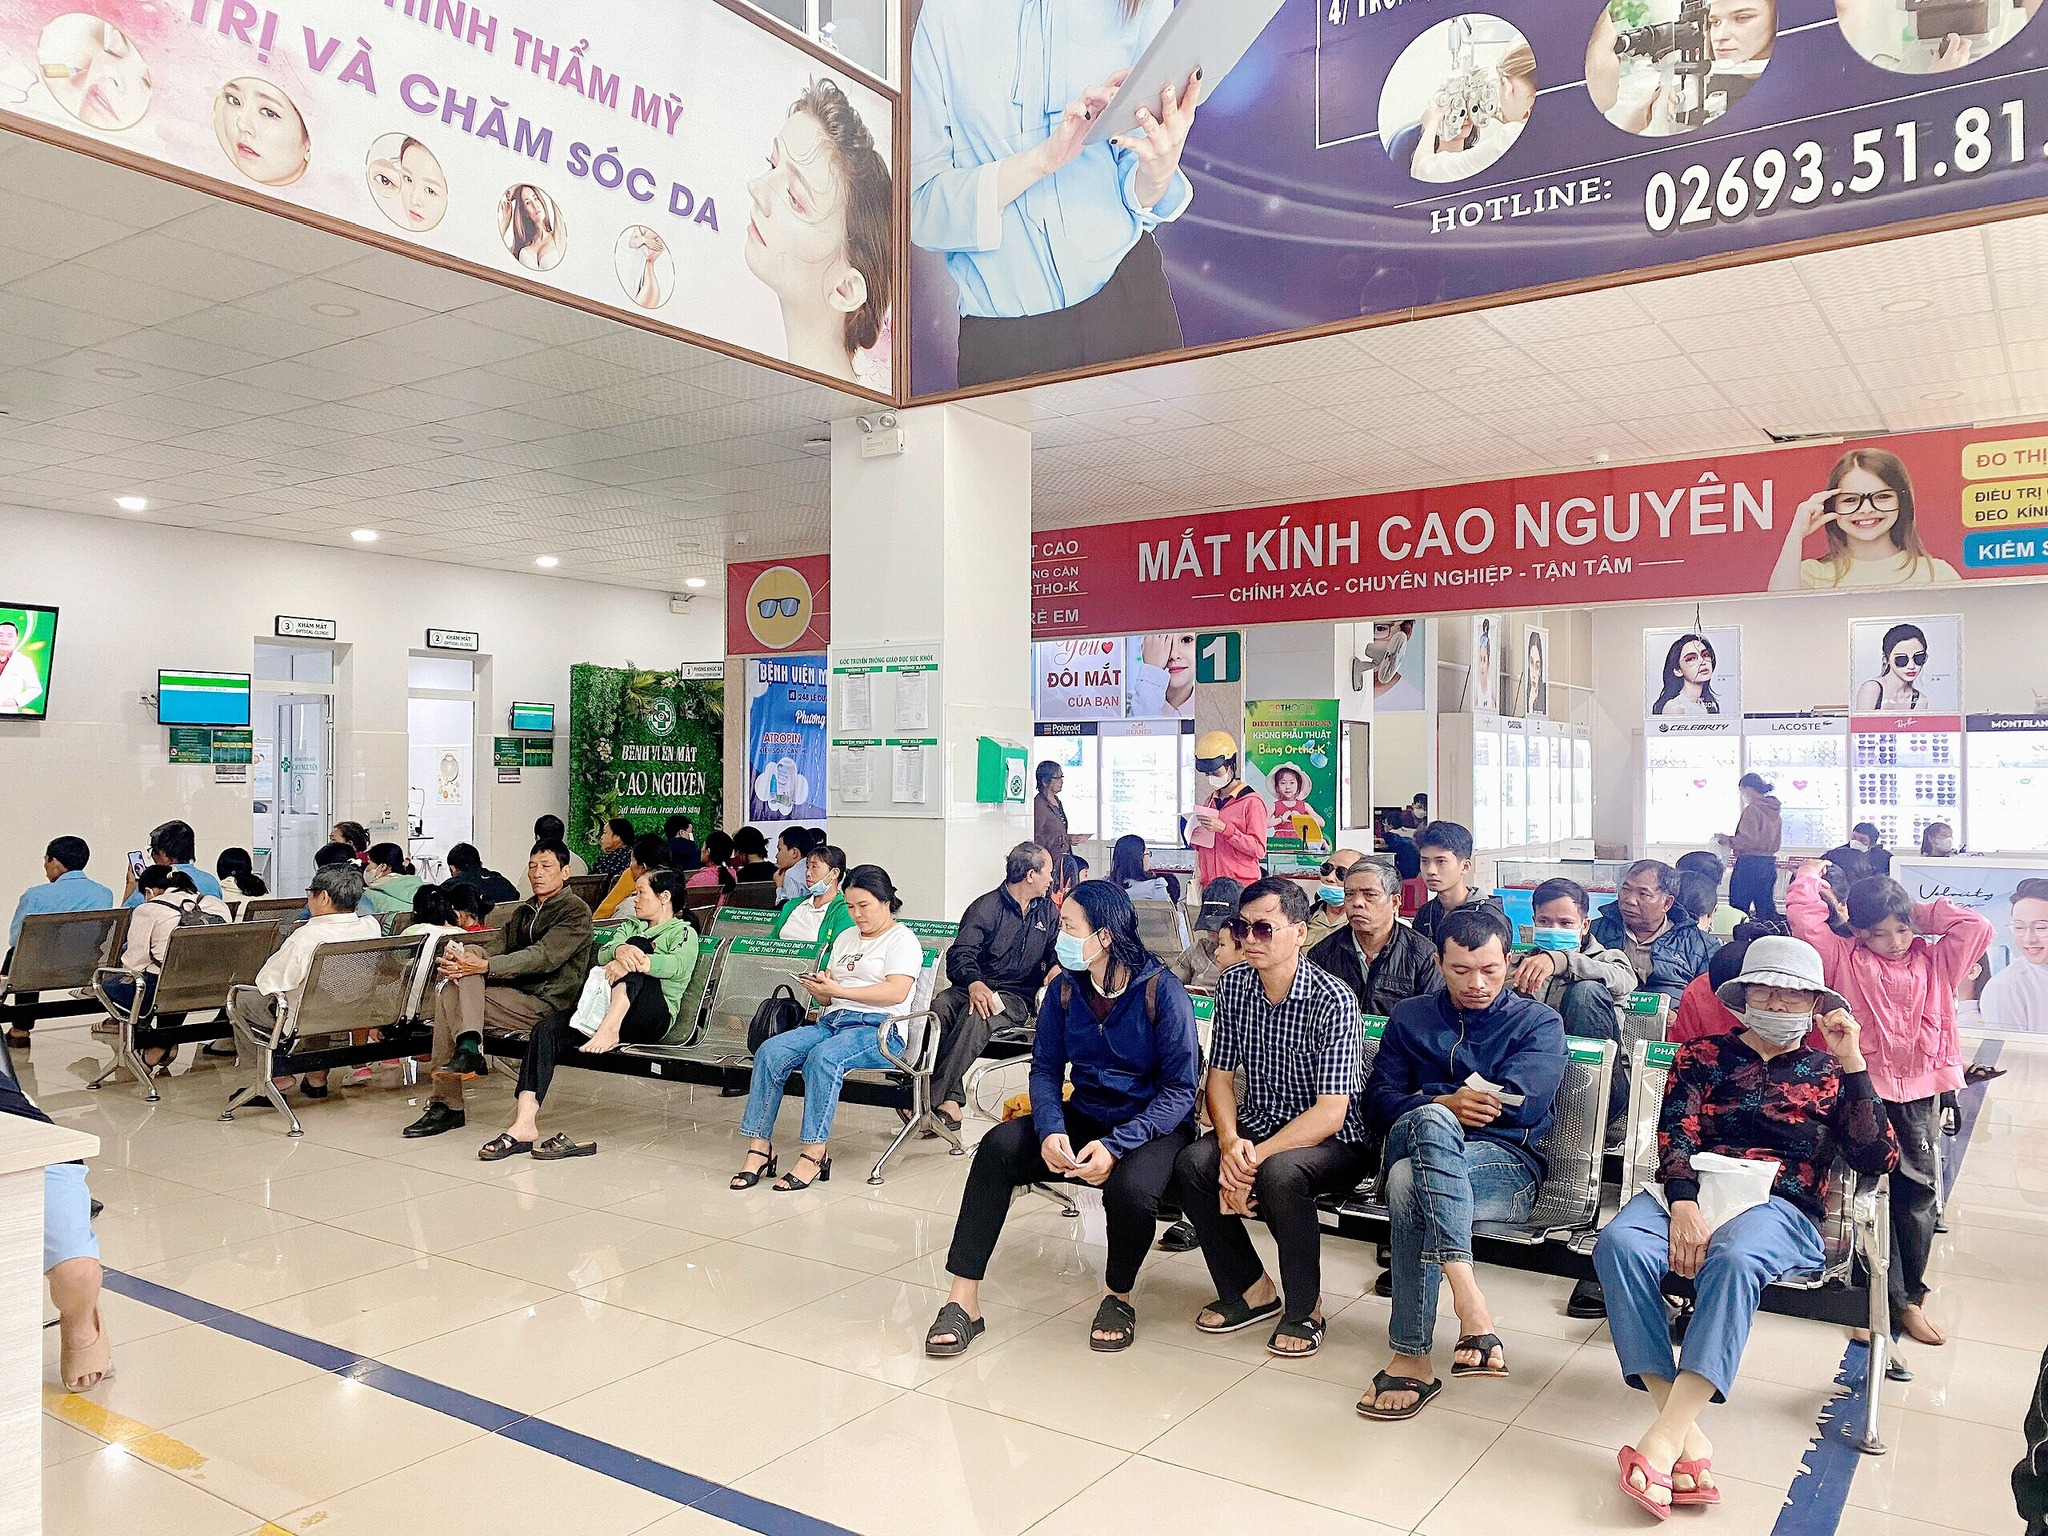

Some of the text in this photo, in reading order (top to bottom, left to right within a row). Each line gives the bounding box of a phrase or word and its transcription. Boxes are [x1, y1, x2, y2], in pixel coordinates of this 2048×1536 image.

[512, 38, 620, 109] THẨM
[302, 25, 377, 95] VÀ
[399, 73, 553, 164] CHĂM
[566, 141, 657, 202] SÓC
[668, 182, 719, 232] DA
[1430, 177, 1613, 234] HOTLINE:
[1976, 453, 2008, 468] ĐO
[2016, 487, 2041, 500] TRỊ
[1975, 509, 2008, 522] ĐEO
[1138, 471, 1773, 582] MẮT KÍNH CAO NGUYÊN
[1042, 540, 1079, 556] CAO
[1229, 555, 1632, 602] CHÍNH XÁC CHUYÊN NGHIỆP TẬN TÂM
[1053, 609, 1079, 623] EM
[1202, 636, 1227, 681] 1
[760, 660, 788, 684] BỆNH
[1047, 662, 1121, 688] ĐÔI MẮT
[818, 694, 827, 702] DU
[1095, 696, 1119, 709] BẠN
[1052, 723, 1081, 732] Polaroid
[1669, 723, 1730, 732] CELEBRITY
[1771, 723, 1821, 731] LACOSTE
[763, 732, 801, 744] ATROPIN
[1253, 730, 1280, 739] KHÔNG
[1303, 730, 1331, 740] THUẬT
[651, 741, 674, 766] VIỆN
[1285, 744, 1325, 755] Ortho-K
[615, 767, 706, 796] CAO NGUYÊN
[1919, 884, 1994, 901] Velocity
[1654, 1046, 1677, 1056] PHẪ
